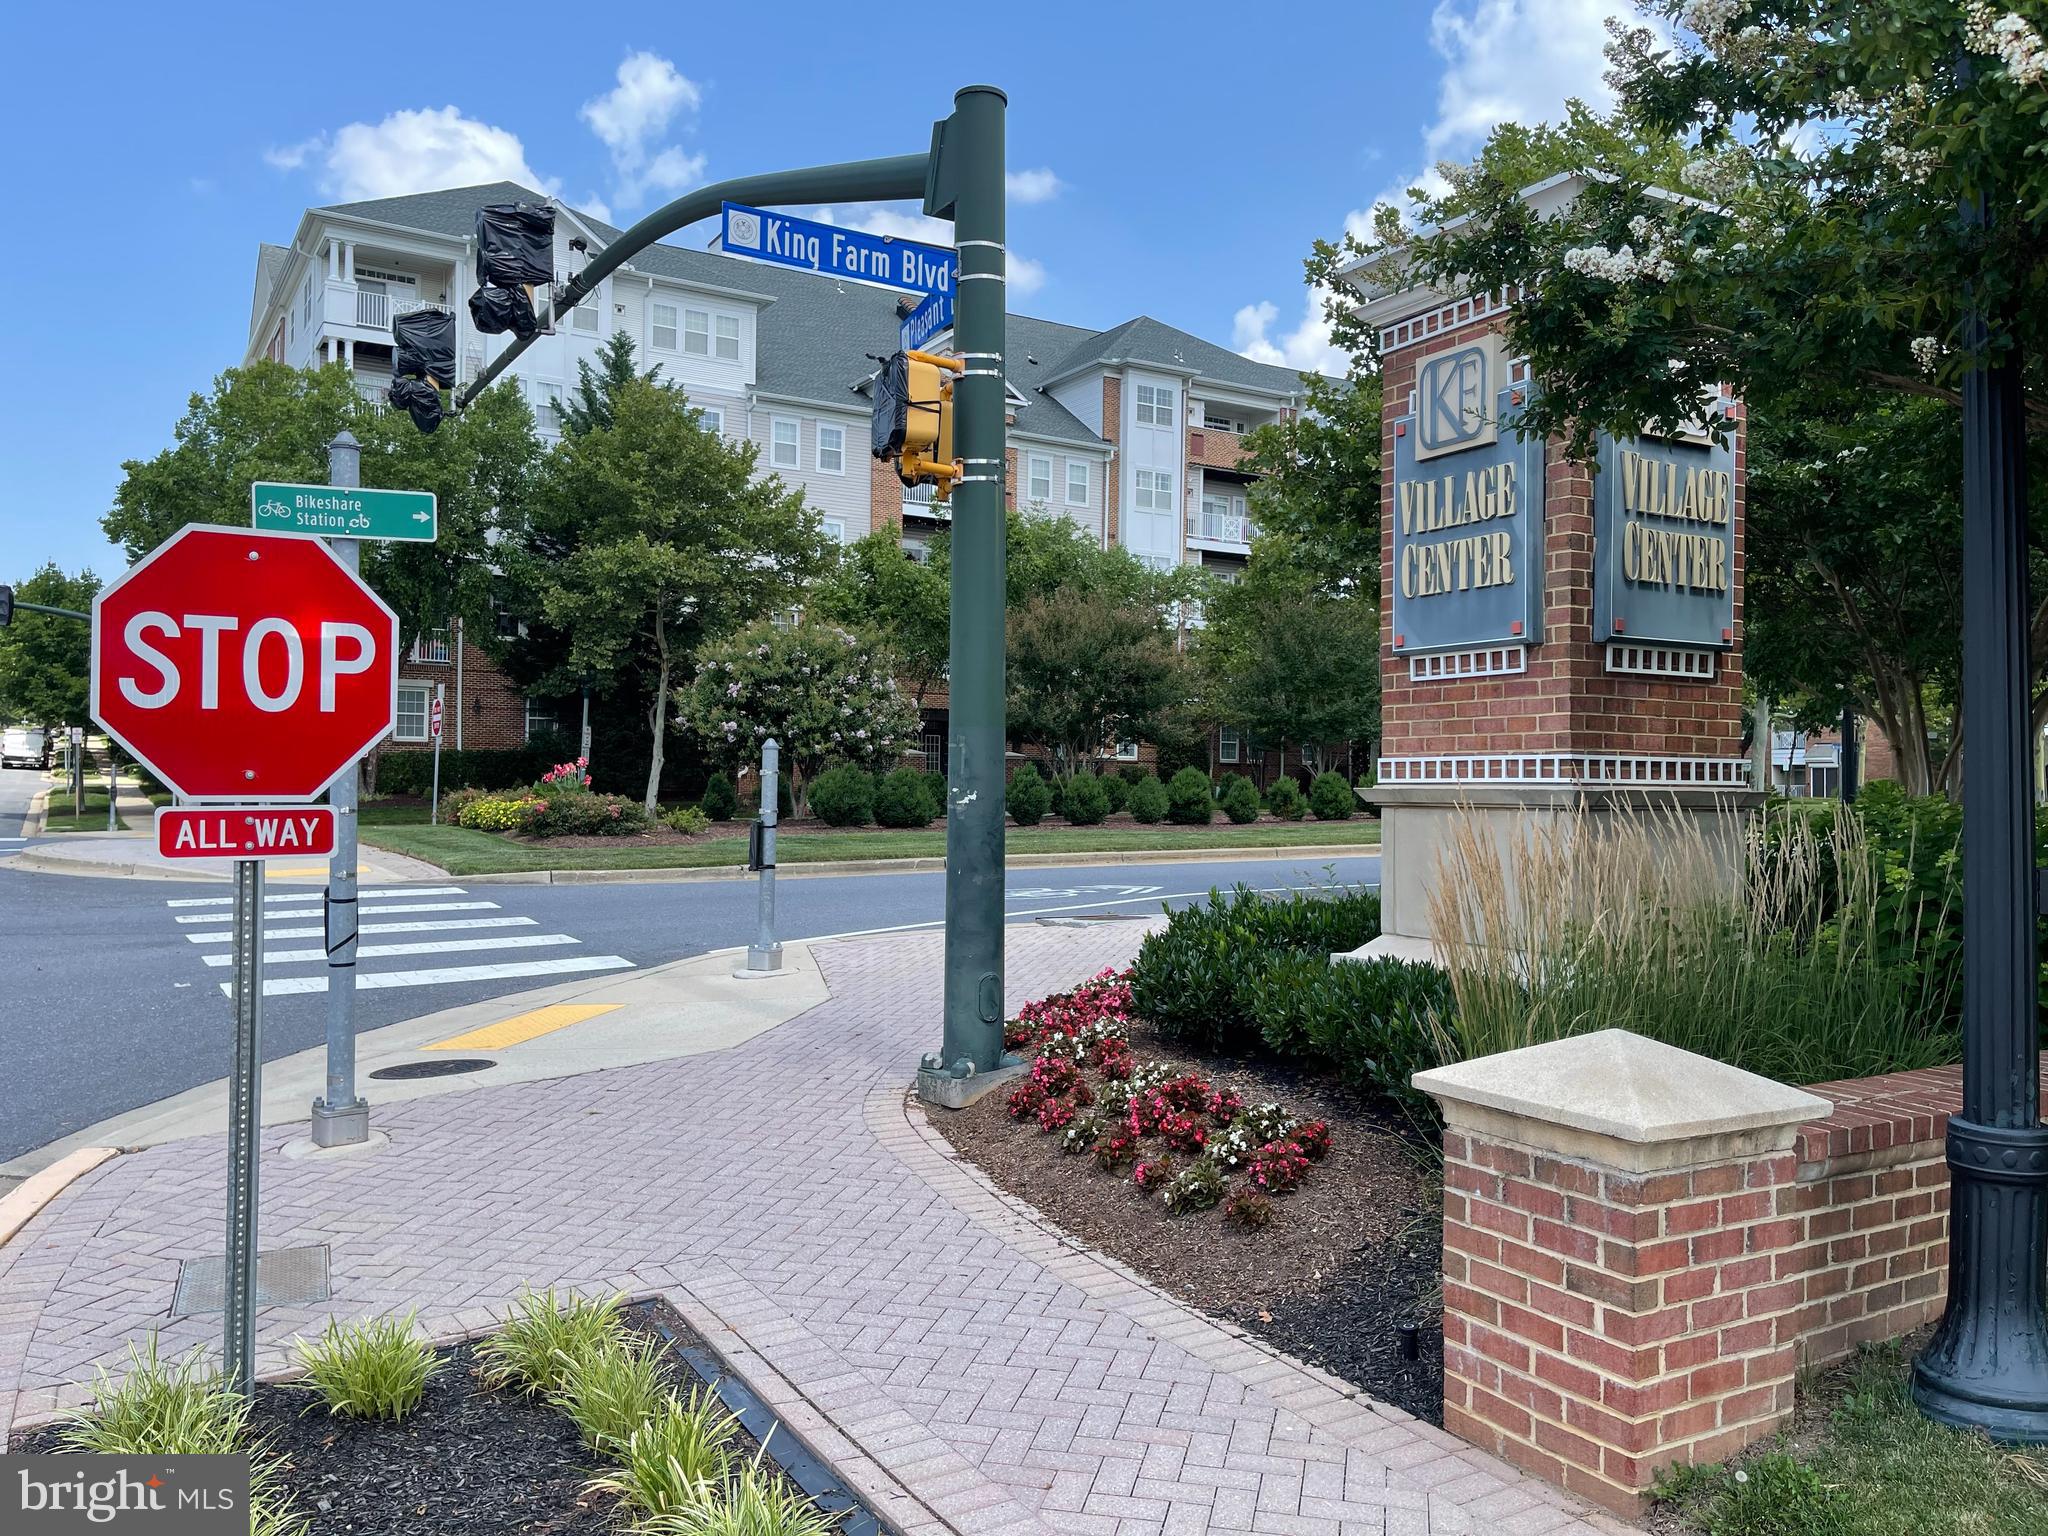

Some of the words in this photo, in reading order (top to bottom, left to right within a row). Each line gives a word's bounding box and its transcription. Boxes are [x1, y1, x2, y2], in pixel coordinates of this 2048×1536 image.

[767, 217, 820, 270] King
[832, 233, 890, 278] Farm
[902, 250, 949, 292] Blvd
[910, 296, 944, 349] Pleasant
[296, 494, 362, 511] Bikeshare
[296, 512, 345, 527] Station
[1399, 462, 1517, 535] VILLAGE
[1620, 450, 1731, 525] VILLAGE
[1401, 532, 1516, 599] CENTER
[1622, 520, 1728, 592] CENTER
[118, 611, 377, 713] STOP
[175, 819, 238, 850] ALL
[254, 817, 320, 847] WAY
